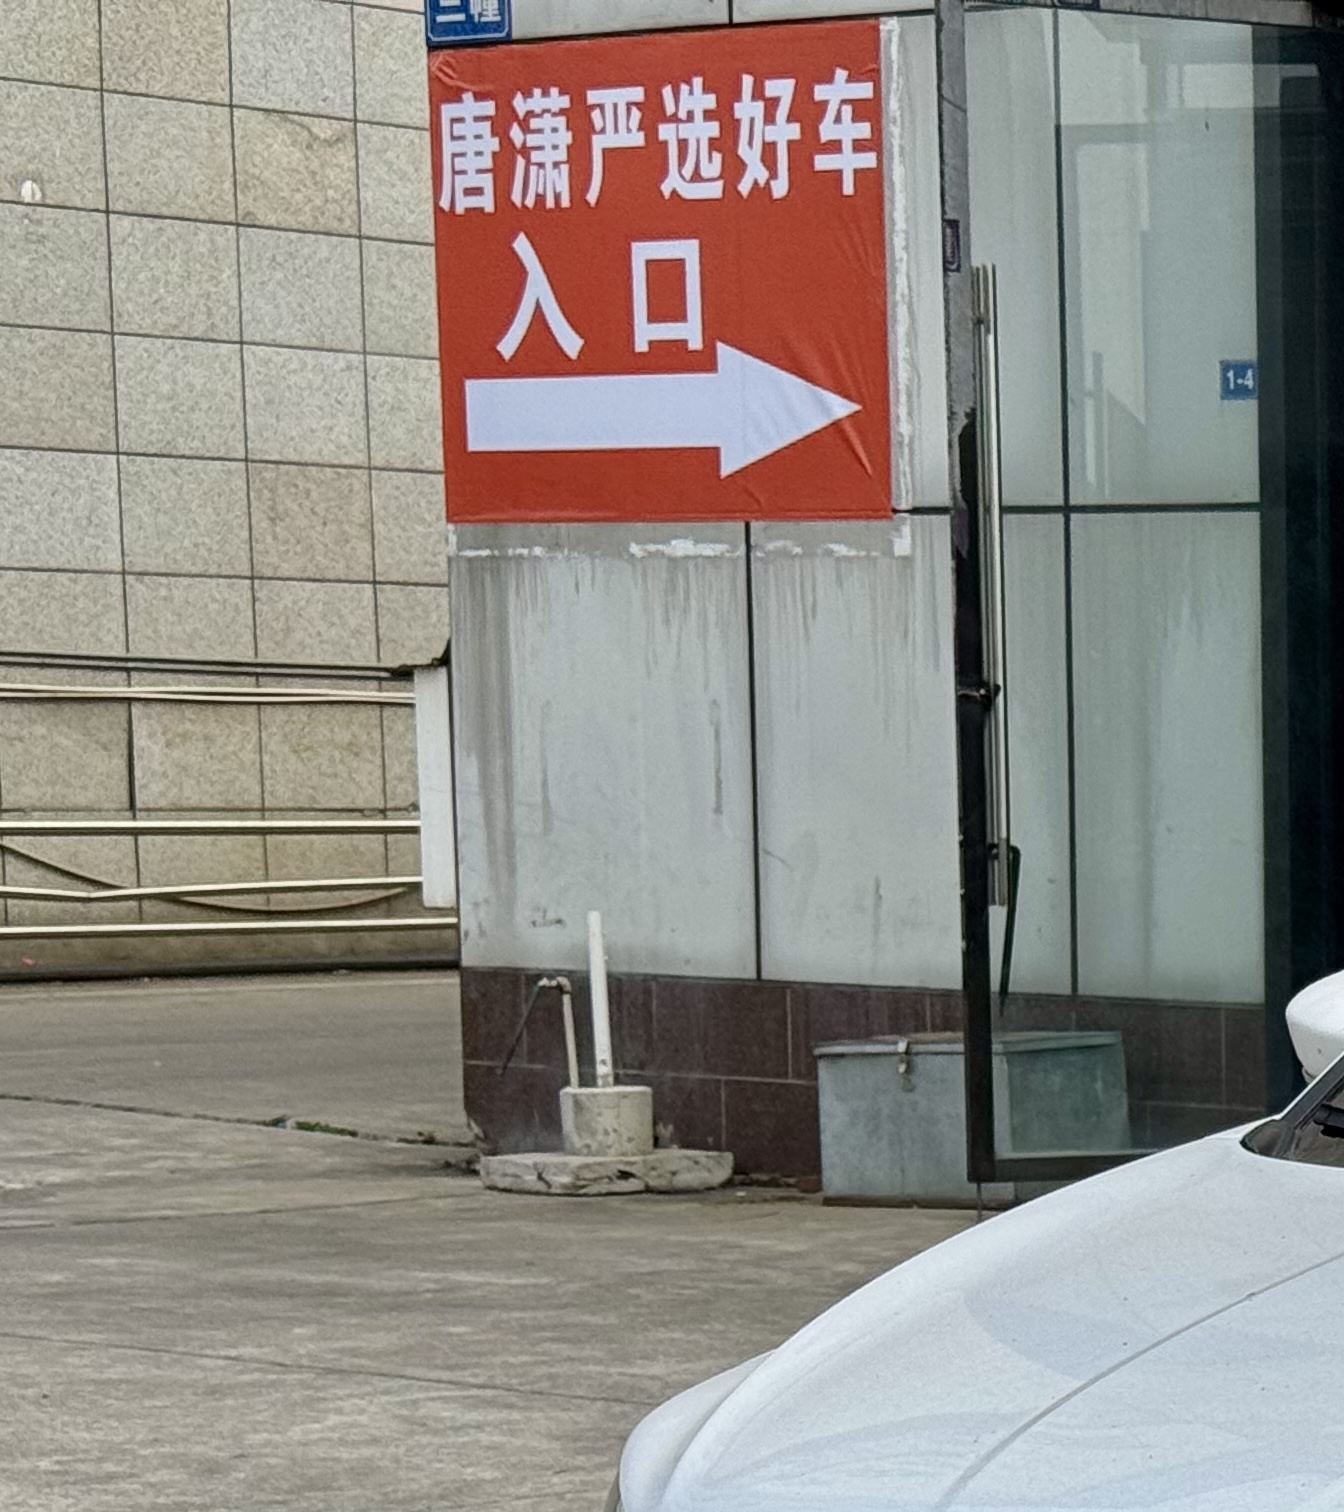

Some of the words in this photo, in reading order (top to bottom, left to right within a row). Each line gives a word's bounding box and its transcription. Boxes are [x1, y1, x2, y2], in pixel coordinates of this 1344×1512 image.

[438, 67, 878, 215] 唐潇严选好车
[495, 231, 703, 361] 入口
[1226, 369, 1255, 390] 1-4
